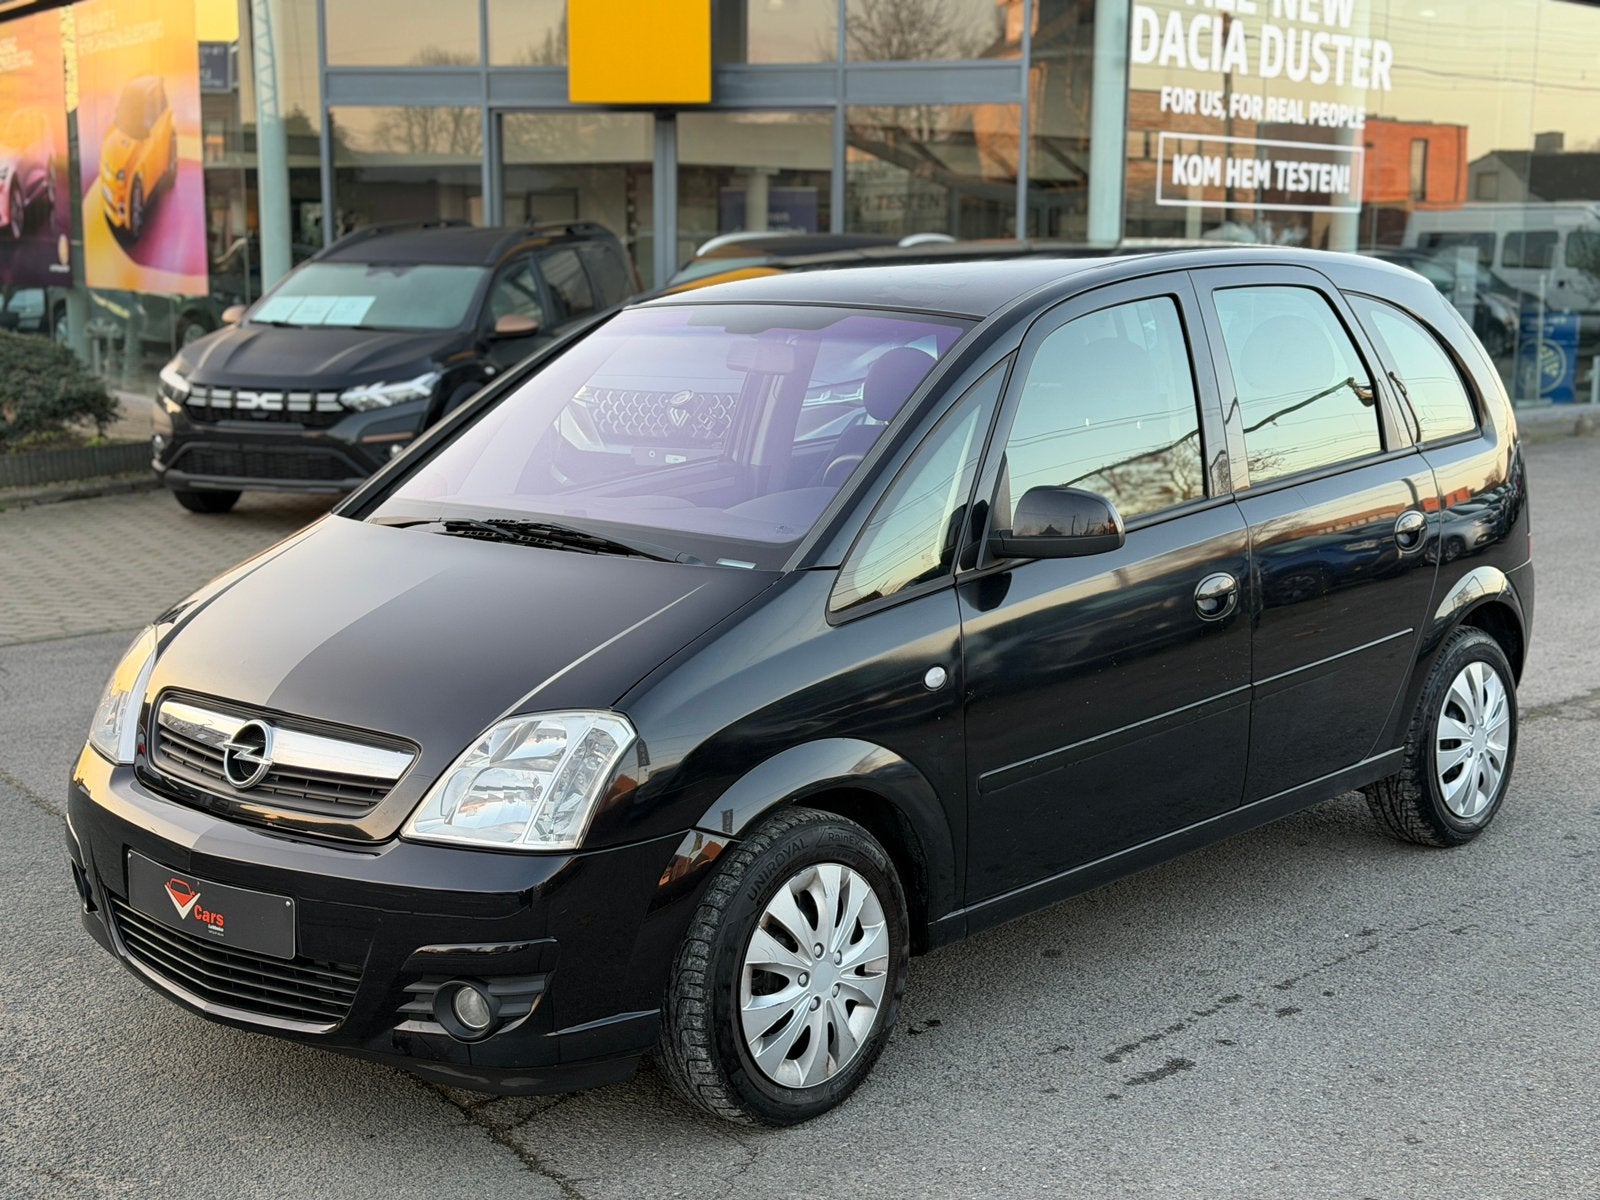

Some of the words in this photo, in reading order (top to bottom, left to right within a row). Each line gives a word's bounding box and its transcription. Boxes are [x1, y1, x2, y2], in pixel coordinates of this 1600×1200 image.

[1131, 5, 1248, 75] DACIA
[1259, 24, 1393, 91] DUSTER
[1160, 86, 1197, 115] FOR
[1200, 90, 1227, 120] US,
[1229, 93, 1264, 121] FOR
[1265, 96, 1307, 125] REAL
[1309, 101, 1366, 130] PEOPLE
[1172, 153, 1222, 187] KOM
[1225, 156, 1272, 190] HEM
[1274, 160, 1350, 195] TESTEN!
[746, 837, 809, 901] UNIROYAL
[193, 904, 225, 928] Cars
